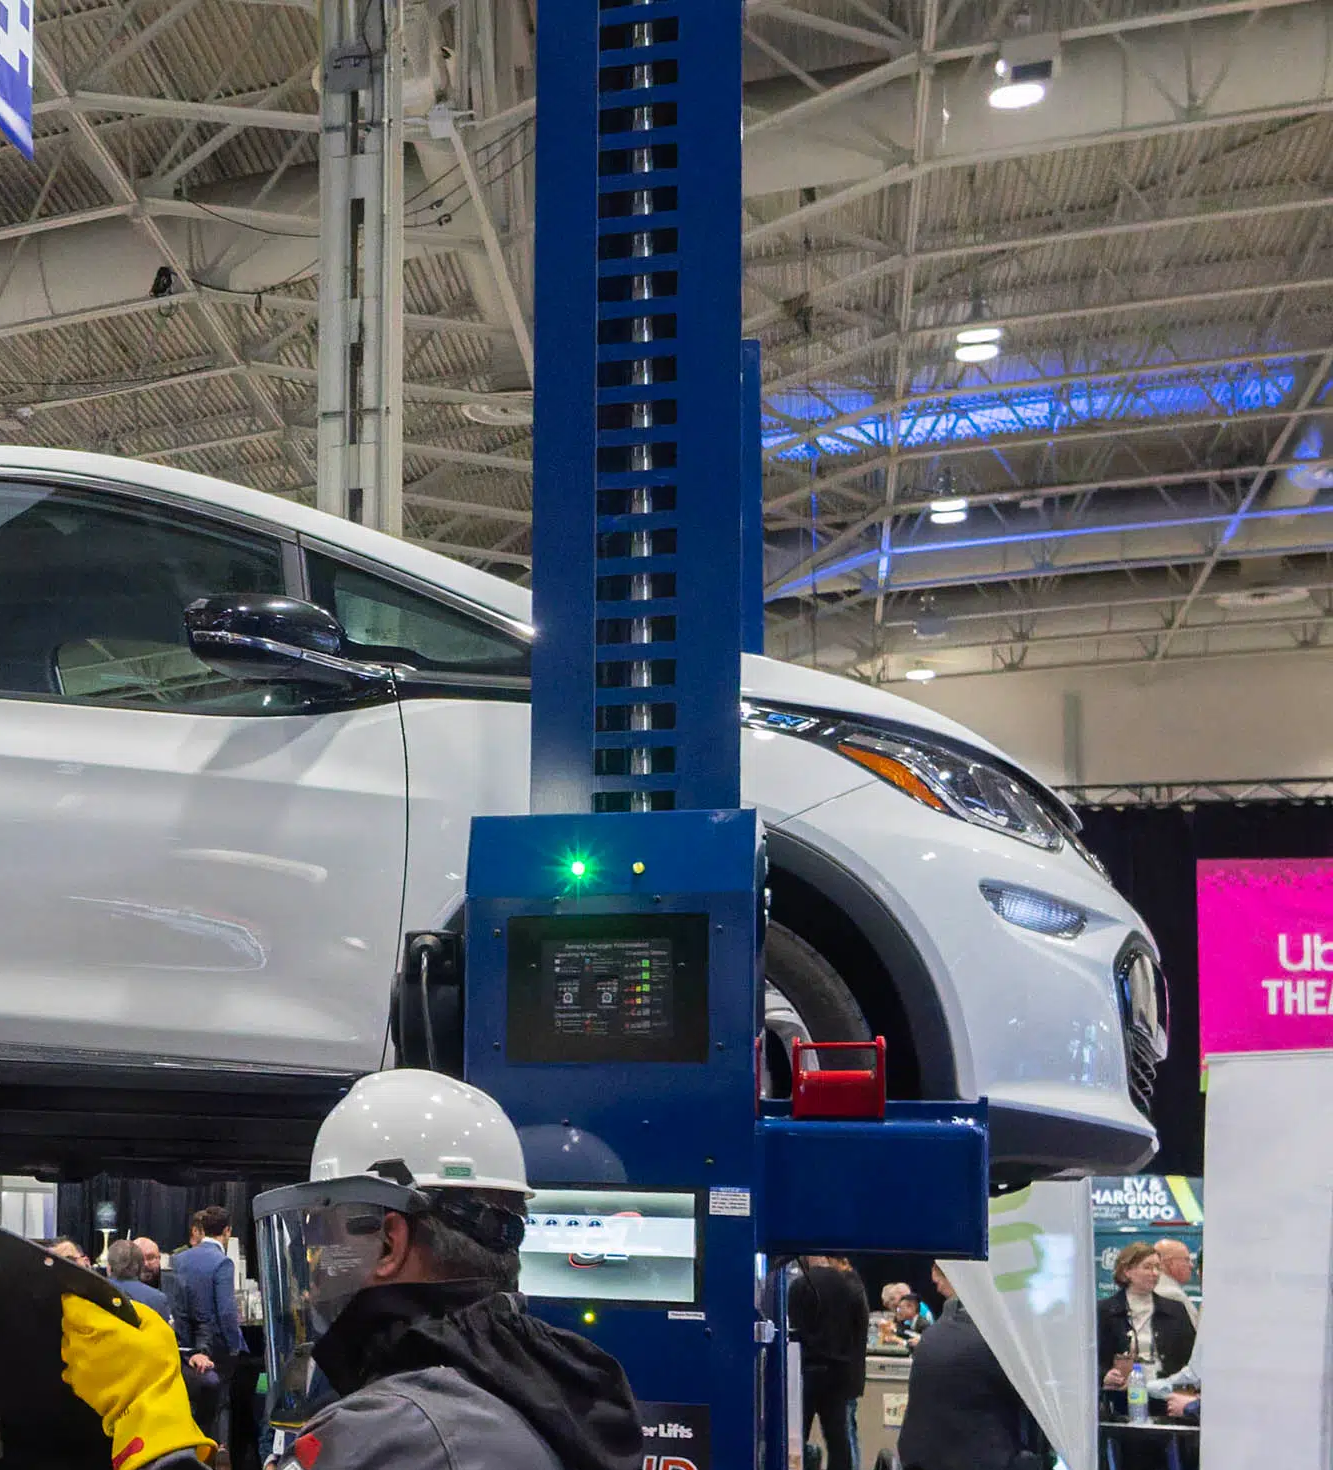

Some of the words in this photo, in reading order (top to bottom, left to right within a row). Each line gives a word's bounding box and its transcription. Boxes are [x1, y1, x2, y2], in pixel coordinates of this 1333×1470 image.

[1261, 979, 1333, 1015] THE
[1123, 1177, 1146, 1192] EV
[1091, 1189, 1168, 1206] HARGING
[1127, 1204, 1175, 1221] EXPO
[658, 1422, 694, 1439] Lifts
